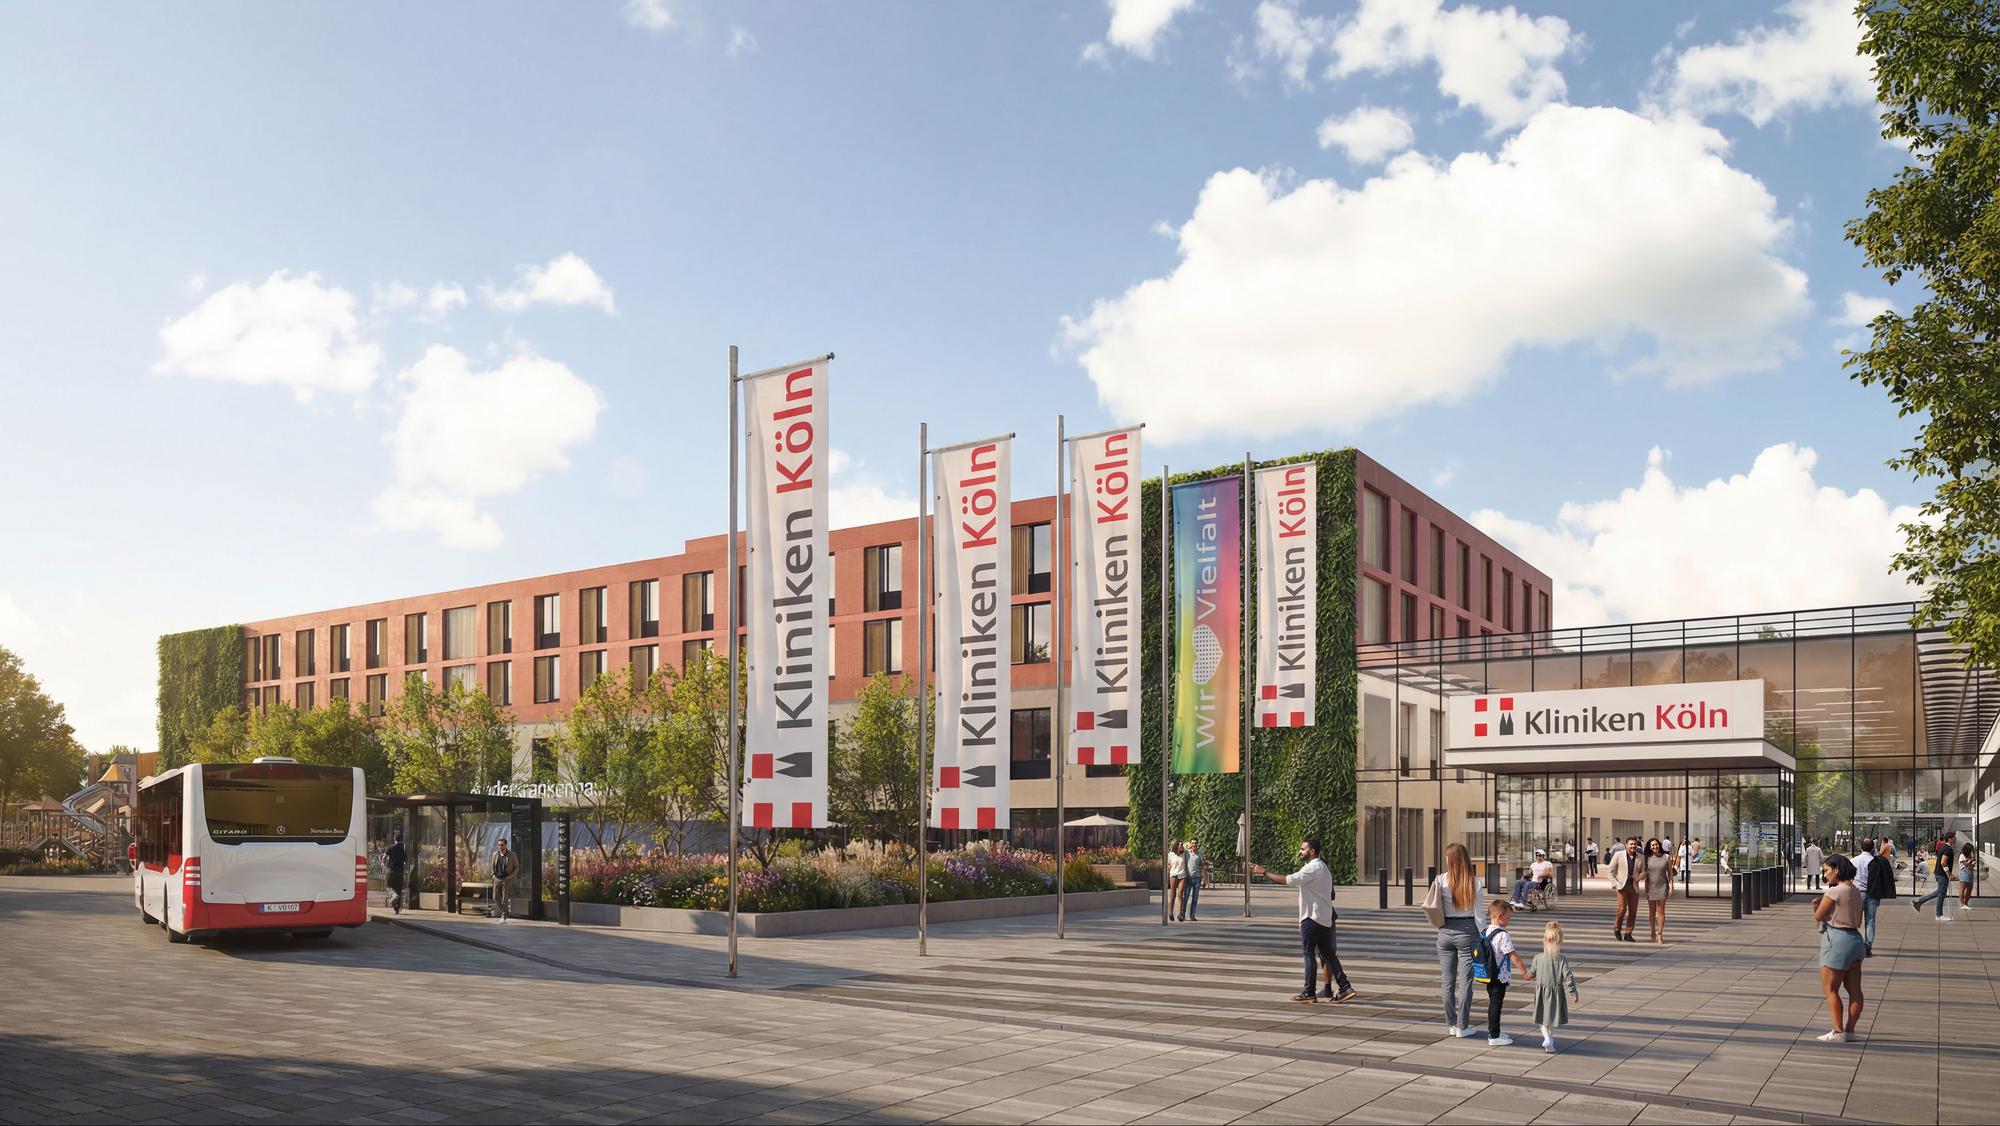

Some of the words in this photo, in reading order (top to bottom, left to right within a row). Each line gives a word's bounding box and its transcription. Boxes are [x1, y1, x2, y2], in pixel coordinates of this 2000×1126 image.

[773, 367, 814, 494] Köln
[1094, 433, 1129, 524] Köln
[959, 443, 997, 549] Köln
[1196, 496, 1217, 621] Vielfalt
[1277, 466, 1307, 538] Köln
[773, 508, 814, 729] Kliniken
[959, 561, 997, 746] Kliniken
[1094, 534, 1128, 694] Kliniken
[1277, 547, 1306, 672] Kliniken
[1196, 687, 1217, 749] Wir
[1525, 706, 1645, 735] Kliniken
[1655, 701, 1729, 730] Köln
